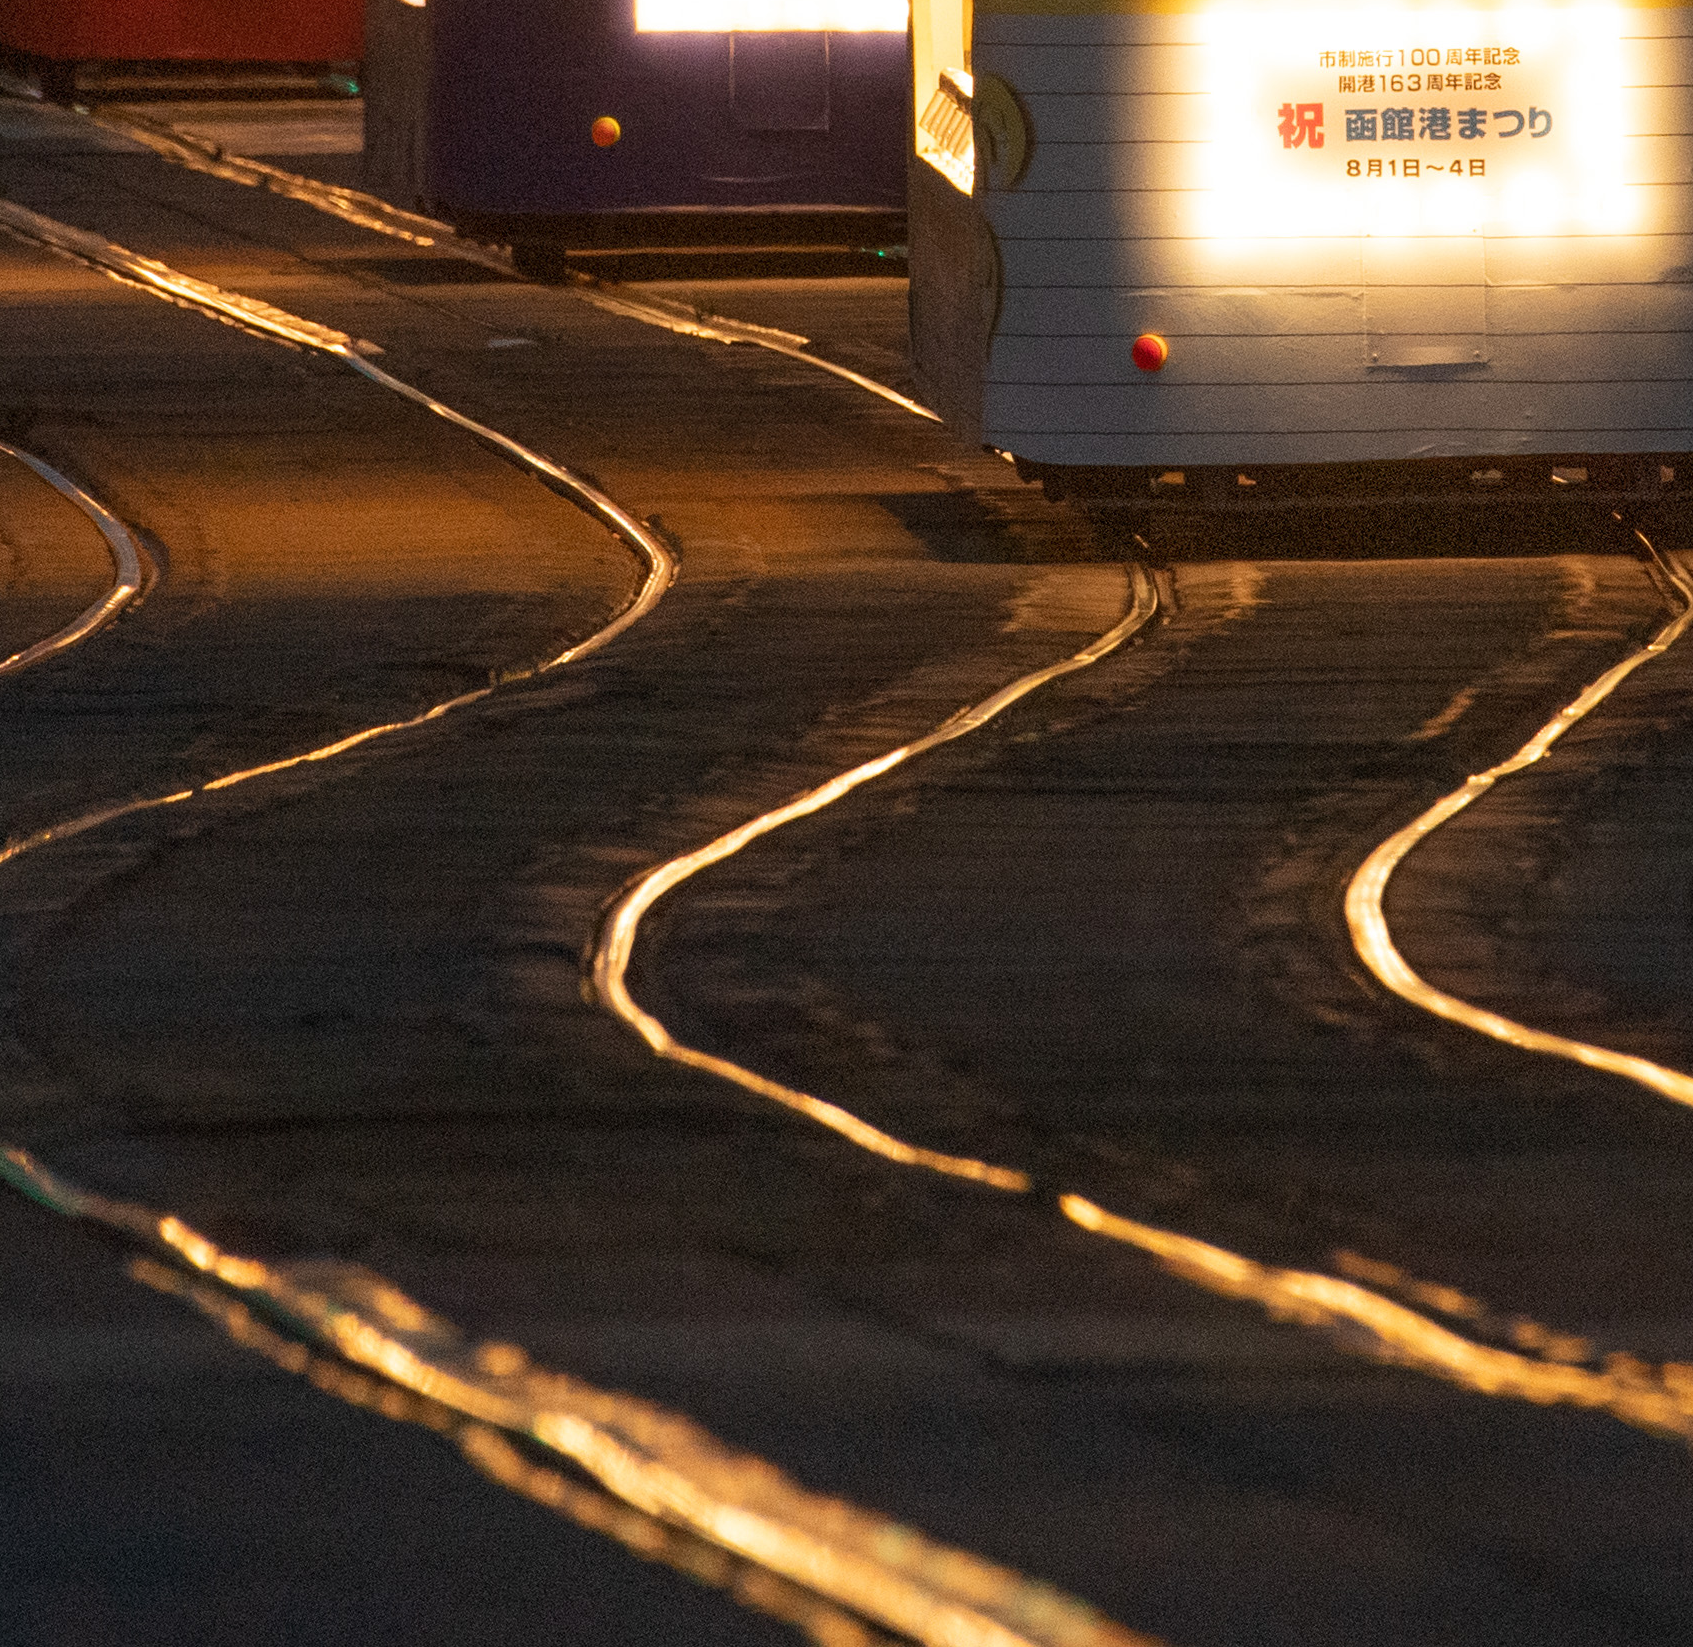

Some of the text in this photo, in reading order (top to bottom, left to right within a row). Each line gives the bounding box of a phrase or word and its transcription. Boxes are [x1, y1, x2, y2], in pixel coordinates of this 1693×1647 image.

[1277, 103, 1553, 149] 祝 函館港まつり
